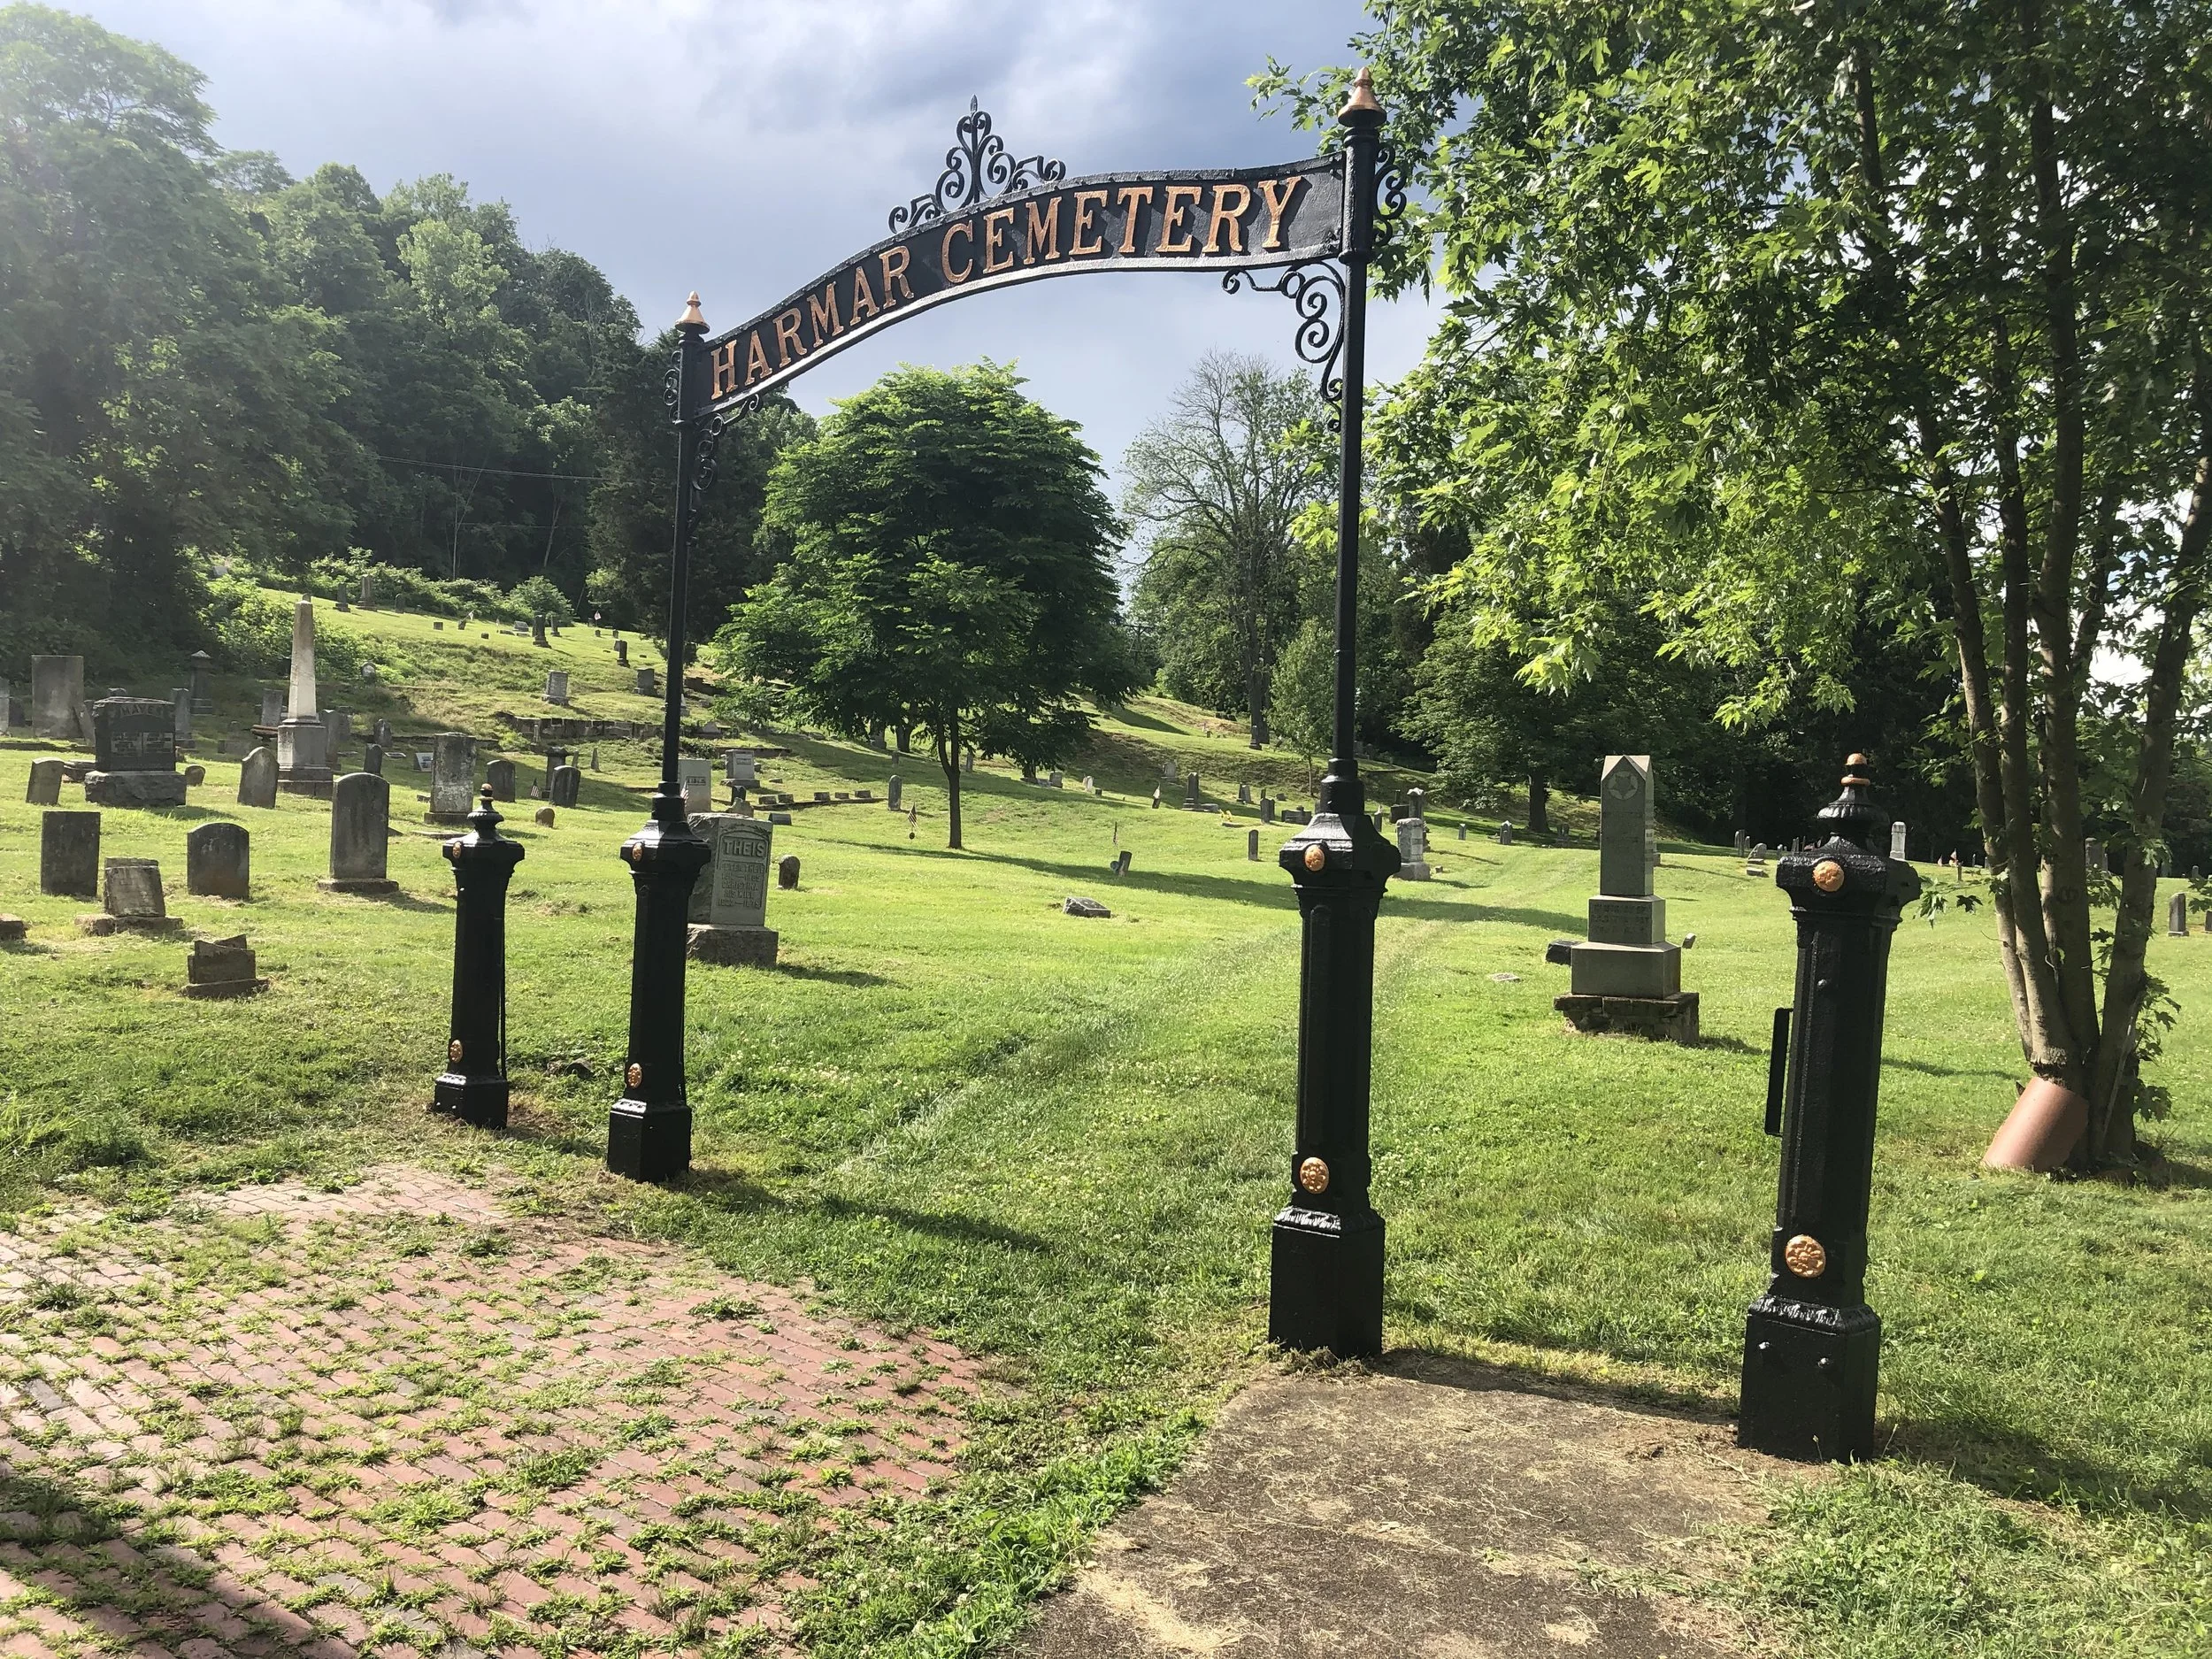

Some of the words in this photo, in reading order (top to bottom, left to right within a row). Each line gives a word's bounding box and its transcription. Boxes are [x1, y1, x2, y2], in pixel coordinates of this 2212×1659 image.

[710, 245, 915, 401] HARMAR
[941, 175, 1302, 284] CEMETERY
[724, 839, 765, 858] THEIS
